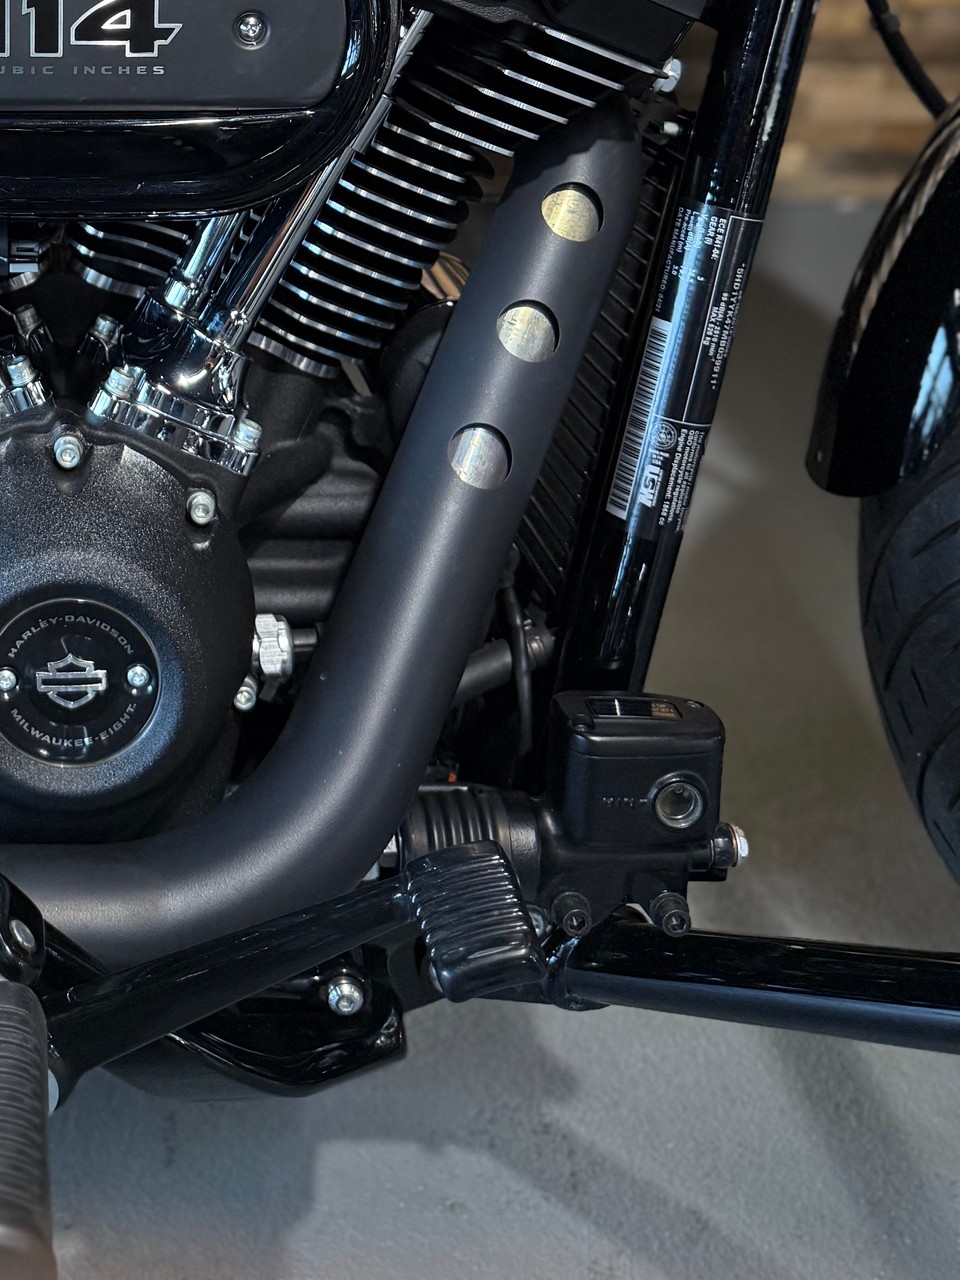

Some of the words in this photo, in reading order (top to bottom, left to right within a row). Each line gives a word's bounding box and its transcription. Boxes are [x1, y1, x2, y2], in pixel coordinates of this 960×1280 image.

[73, 65, 165, 75] INCHES
[674, 206, 684, 226] DATE
[706, 215, 718, 237] GEAR
[716, 217, 726, 234] ECE
[658, 227, 679, 292] MANUFACTURED:
[708, 305, 718, 322] MAX
[702, 335, 711, 346] kg
[674, 427, 688, 452] Engine
[663, 451, 682, 499] Displacement:
[675, 445, 690, 484] motorcycle
[8, 614, 134, 658] HARLEY-DAVIDSON
[10, 703, 137, 747] MILWAUKEE-EIGHT
